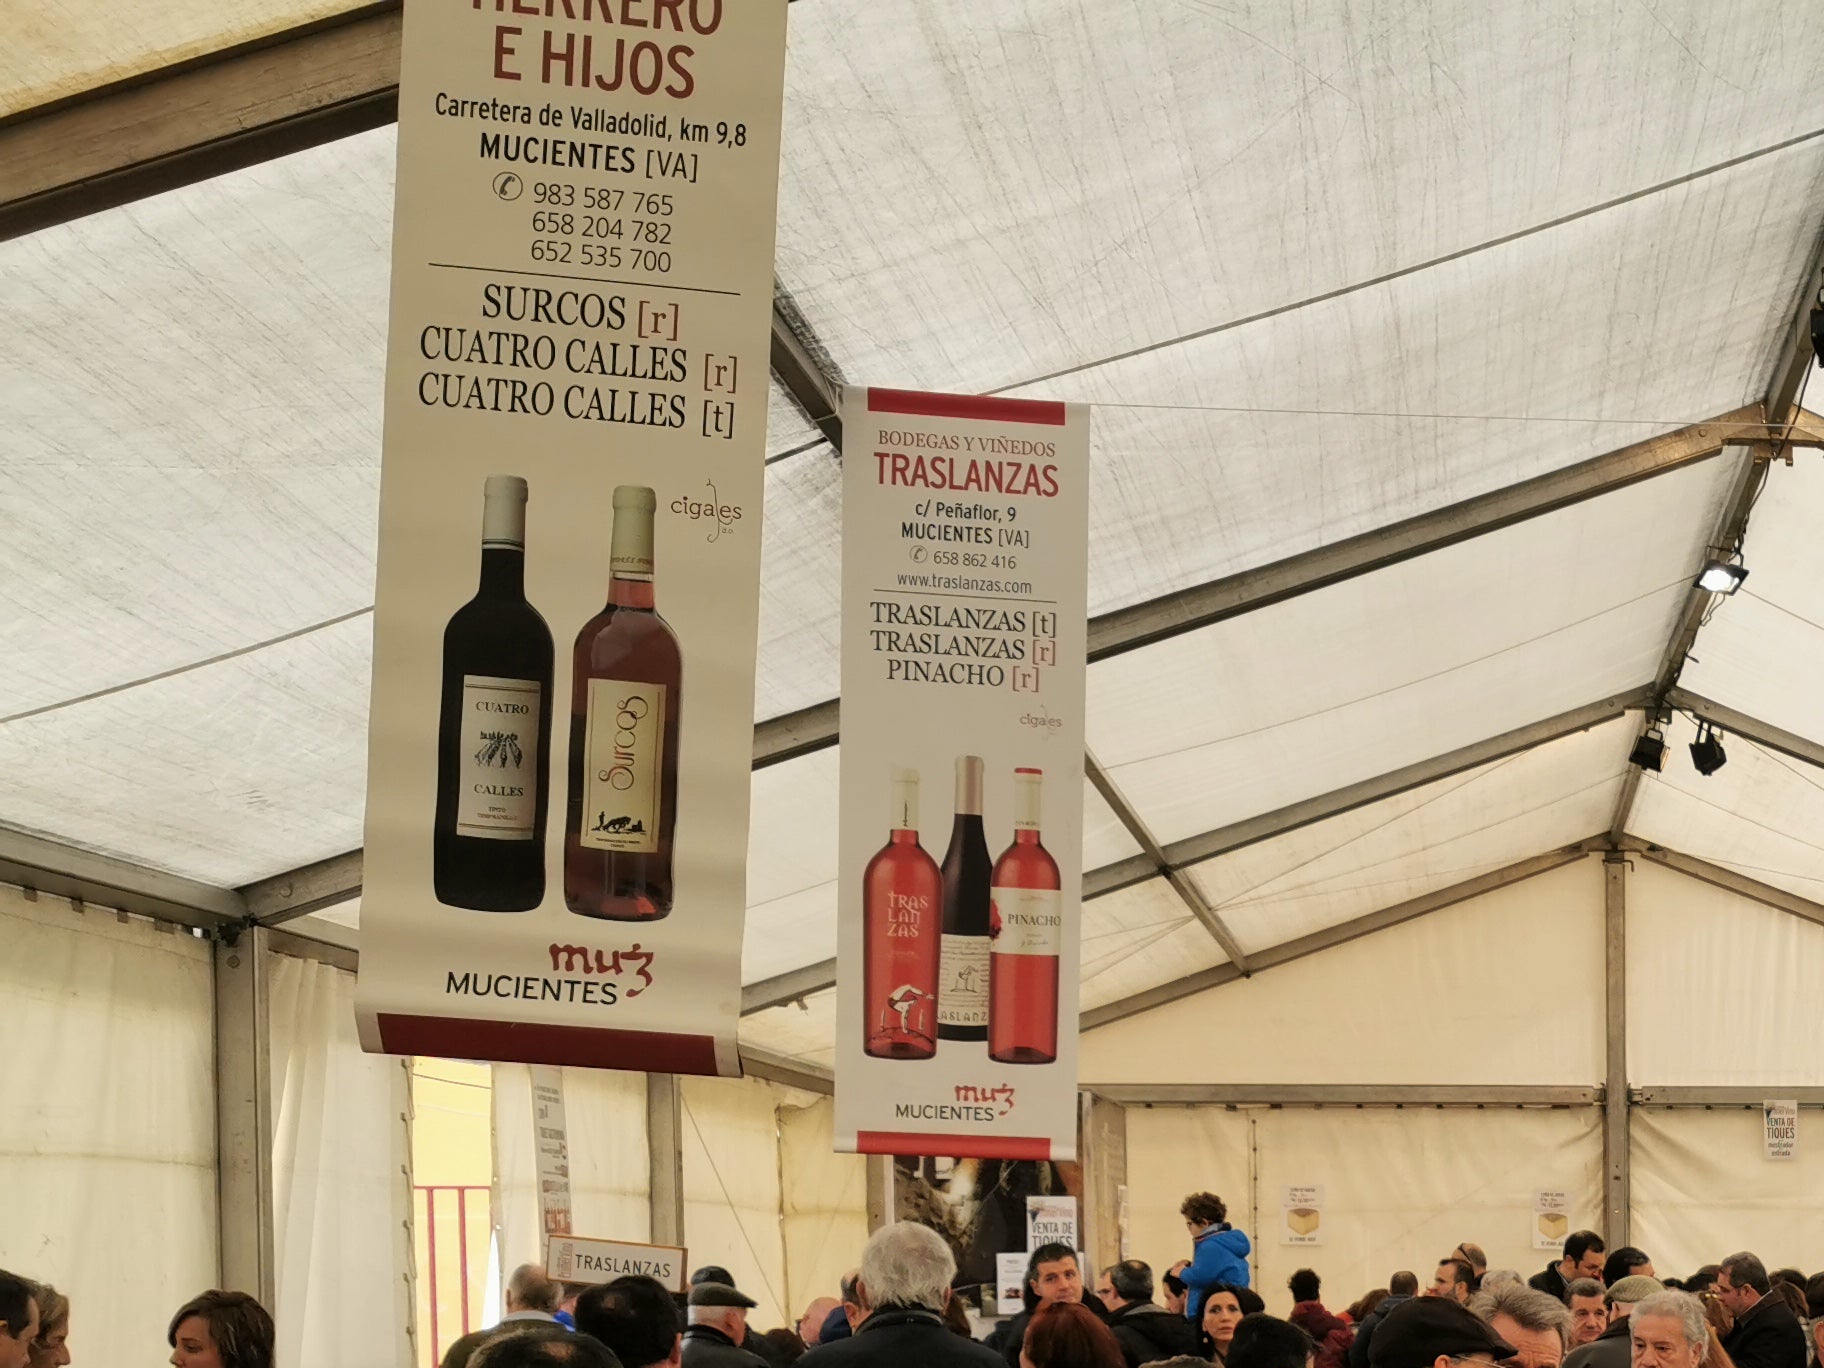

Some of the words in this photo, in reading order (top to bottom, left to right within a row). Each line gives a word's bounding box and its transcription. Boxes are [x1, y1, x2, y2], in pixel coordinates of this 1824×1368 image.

[493, 25, 522, 81] E
[541, 30, 696, 99] HIJOS
[435, 92, 531, 126] Carretera
[538, 104, 563, 127] de
[570, 106, 672, 143] Valladolid,
[680, 118, 709, 143] km
[716, 121, 747, 148] 9,8
[480, 133, 636, 173] MUCIENTES
[645, 150, 698, 183] [VA]
[533, 182, 575, 206] 983
[583, 187, 624, 211] 587
[632, 192, 674, 216] 765
[532, 211, 574, 236] 658
[581, 215, 623, 240] 204
[631, 220, 672, 245] 782
[530, 239, 571, 265] 652
[580, 244, 622, 269] 535
[630, 248, 671, 273] 700
[482, 283, 626, 330] SURCOS
[637, 301, 680, 341] [r]
[420, 325, 556, 370] CUATRO
[565, 338, 687, 383] CALLES
[703, 353, 738, 394] [r]
[418, 372, 554, 416] CUATRO
[563, 384, 686, 429] CALLES
[702, 400, 735, 439] [t]
[878, 430, 959, 452] BODEGAS
[963, 437, 976, 451] Y
[978, 435, 1055, 458] VIÑEDOS
[873, 452, 1059, 498] TRASLANZAS
[915, 500, 930, 517] c/
[936, 502, 1002, 524] Peñaflor,
[1007, 508, 1016, 522] 9
[901, 522, 993, 545] MUCIENTES
[999, 529, 1030, 549] [VA]
[933, 551, 959, 566] 658
[962, 553, 988, 568] 862
[991, 555, 1017, 569] 416
[897, 573, 1032, 595] www.traslanzas.com
[870, 601, 1026, 633] TRASLANZAS
[1032, 611, 1057, 639] [t]
[870, 630, 1025, 661] TRASLANZAS
[1032, 640, 1056, 667] [r]
[886, 659, 1005, 687] PINACHO
[1012, 665, 1039, 693] [r]
[475, 701, 530, 715] CUATRO
[474, 784, 524, 797] CALLES
[887, 923, 919, 938] ZAS
[1008, 914, 1061, 927] PINACHO
[446, 971, 618, 1005] MUCIENTES
[896, 1103, 995, 1122] MUCIENTES
[1766, 1117, 1785, 1127] VENTA
[1787, 1117, 1795, 1127] DE
[1767, 1127, 1795, 1139] TIQUES
[1031, 1222, 1059, 1235] VENTA
[1062, 1221, 1073, 1234] DE
[575, 1254, 671, 1278] TRASLANZAS
